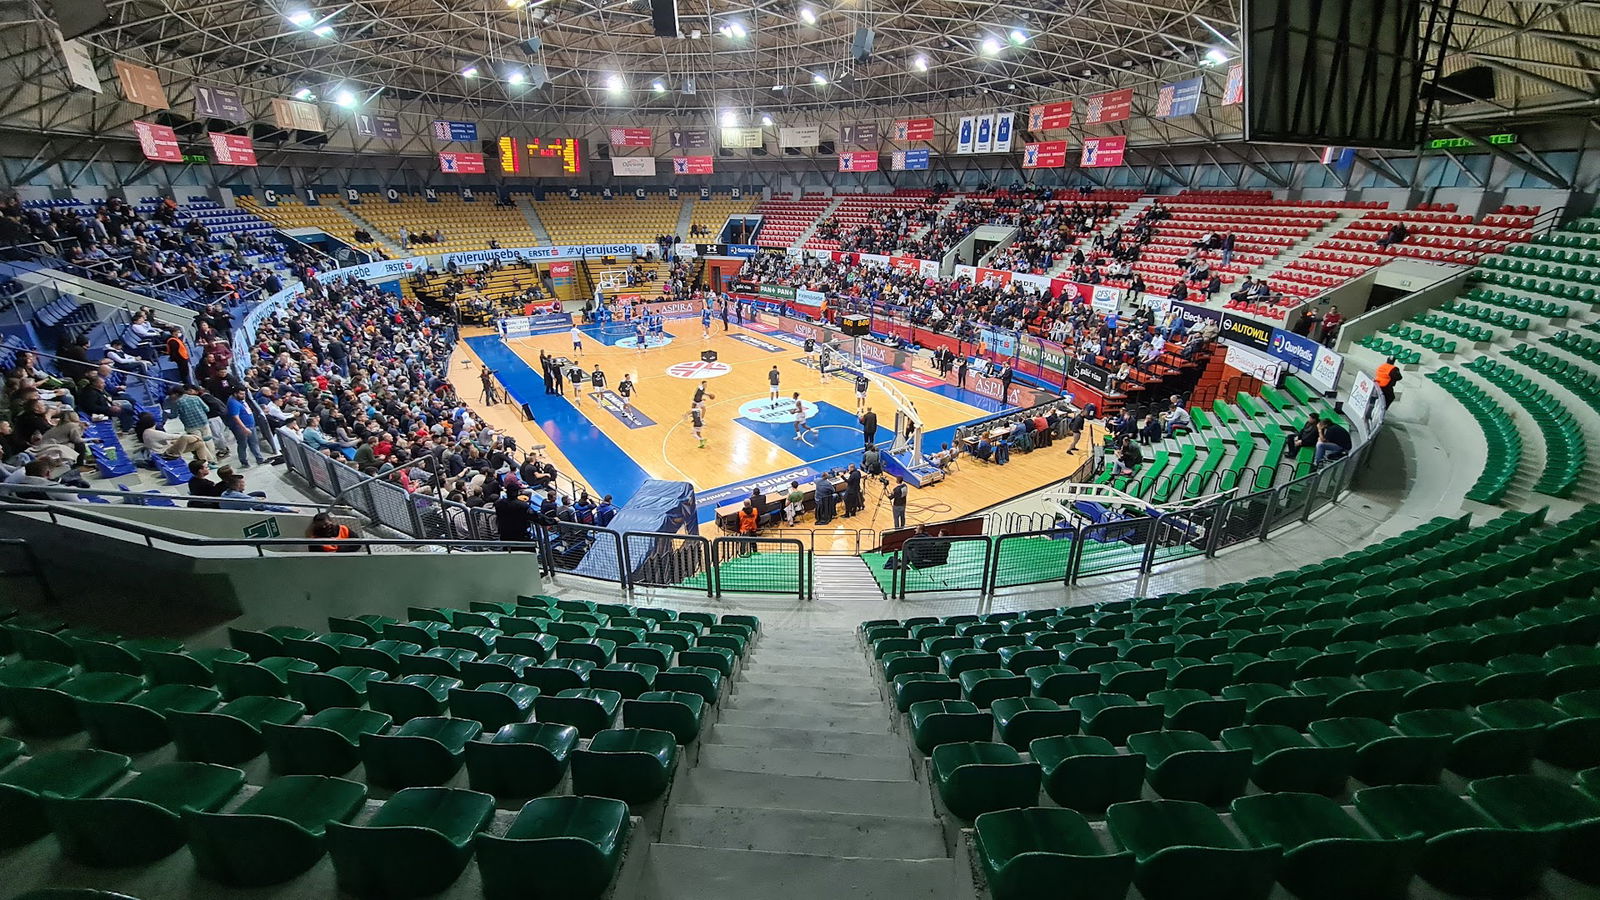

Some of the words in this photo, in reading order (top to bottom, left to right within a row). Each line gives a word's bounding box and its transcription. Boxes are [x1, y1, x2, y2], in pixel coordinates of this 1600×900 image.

[528, 249, 551, 258] ERSTE
[566, 244, 638, 256] #vjerujusebe
[385, 263, 406, 273] ERSTE
[760, 285, 772, 293] PAN
[777, 288, 789, 296] PAN
[662, 302, 693, 314] ASPIRA
[794, 323, 817, 339] ASPIRA
[1231, 322, 1269, 342] AUTOWILL
[856, 341, 896, 358] ASPIRA
[1016, 343, 1033, 356] PAN
[1041, 351, 1059, 363] PAN
[1284, 341, 1313, 361] QuoVadis
[734, 468, 810, 493] ADMIRAL
